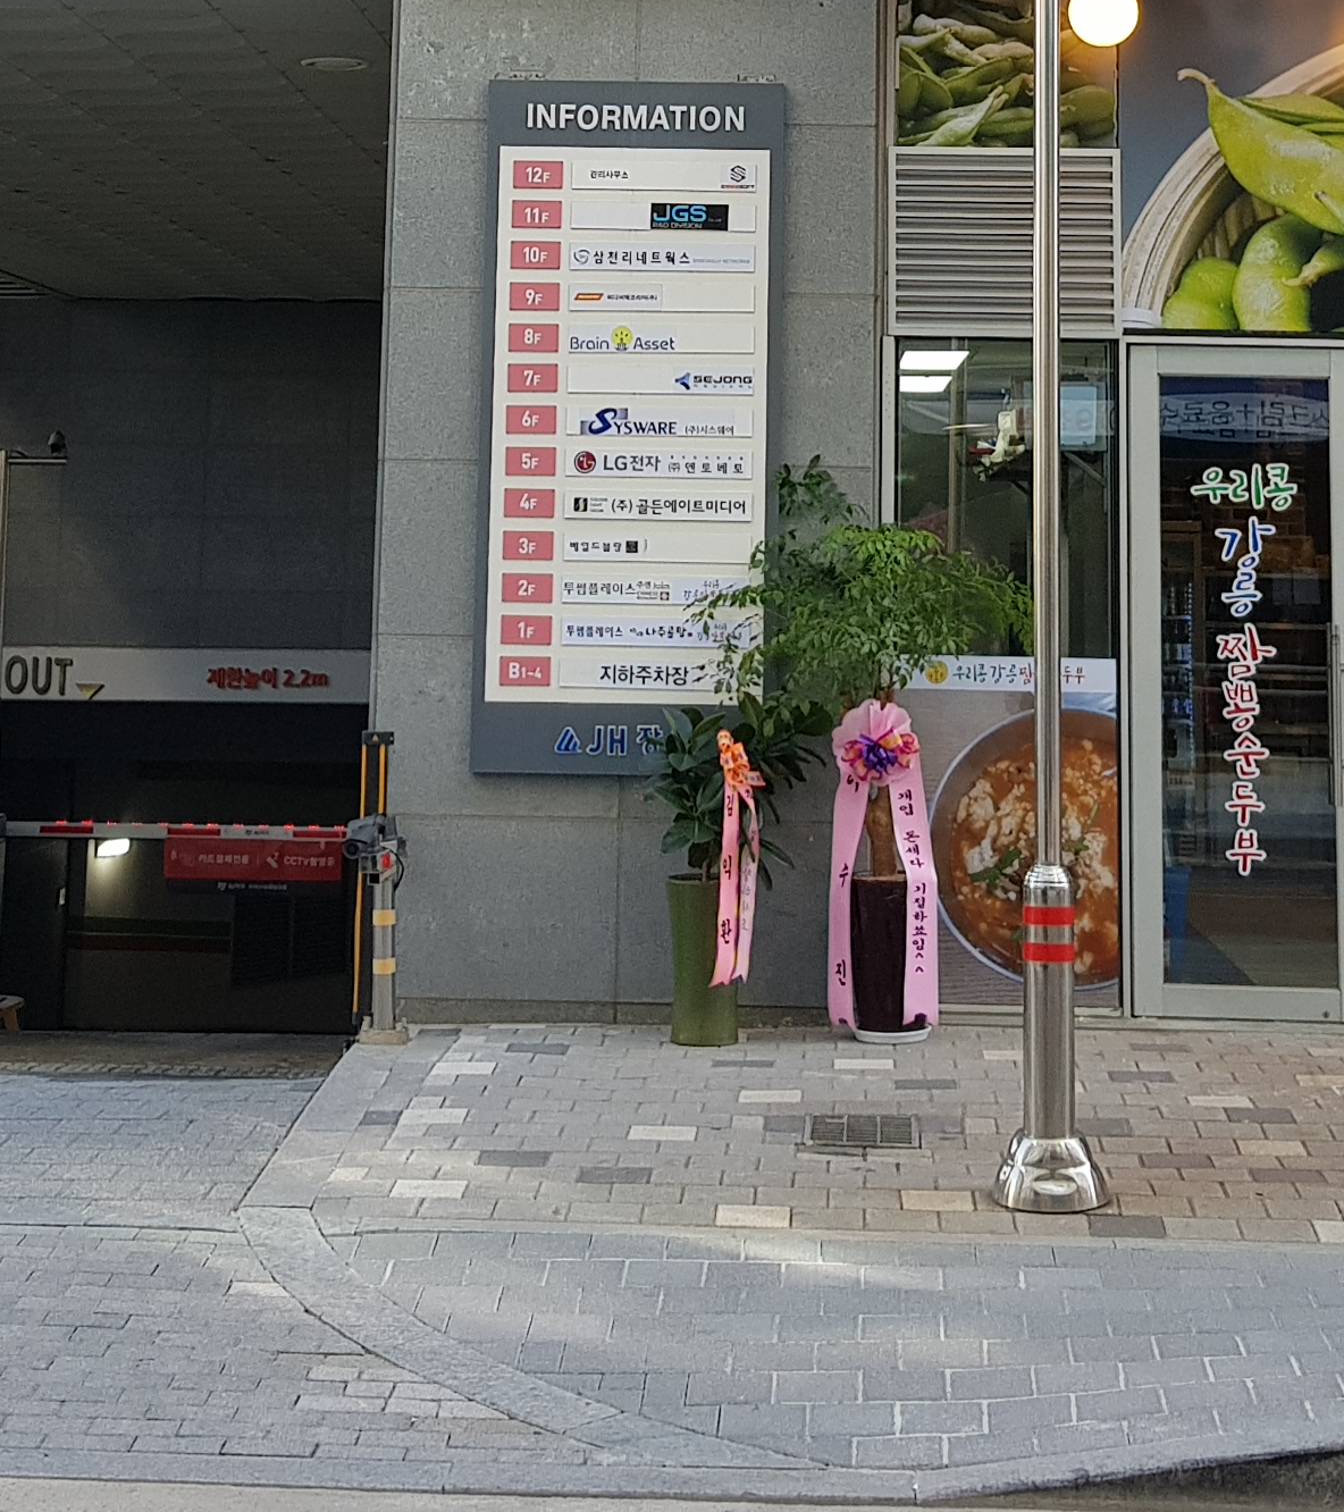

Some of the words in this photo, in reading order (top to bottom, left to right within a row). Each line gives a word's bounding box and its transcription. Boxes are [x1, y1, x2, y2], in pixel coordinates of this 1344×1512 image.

[526, 102, 746, 132] INFORMATION
[525, 167, 551, 183] 12F
[524, 207, 549, 223] 11F
[652, 204, 707, 222] JGS
[522, 246, 548, 262] 10F
[525, 289, 543, 305] 9F
[523, 329, 541, 345] 8F
[570, 336, 609, 351] Brain
[633, 336, 676, 351] Asset
[523, 370, 541, 386] 7F
[521, 411, 539, 427] 6F
[521, 453, 539, 469] 5F
[1191, 463, 1297, 512] 우리콩
[519, 496, 537, 511] 4F
[518, 538, 536, 554] 3F
[1215, 516, 1276, 617] 강릉
[517, 579, 535, 596] 2F
[517, 621, 535, 637] 1F
[4, 654, 74, 696] OUT
[282, 668, 330, 688] 2.2m
[600, 664, 690, 686] 지하주차장
[586, 725, 628, 756] JH
